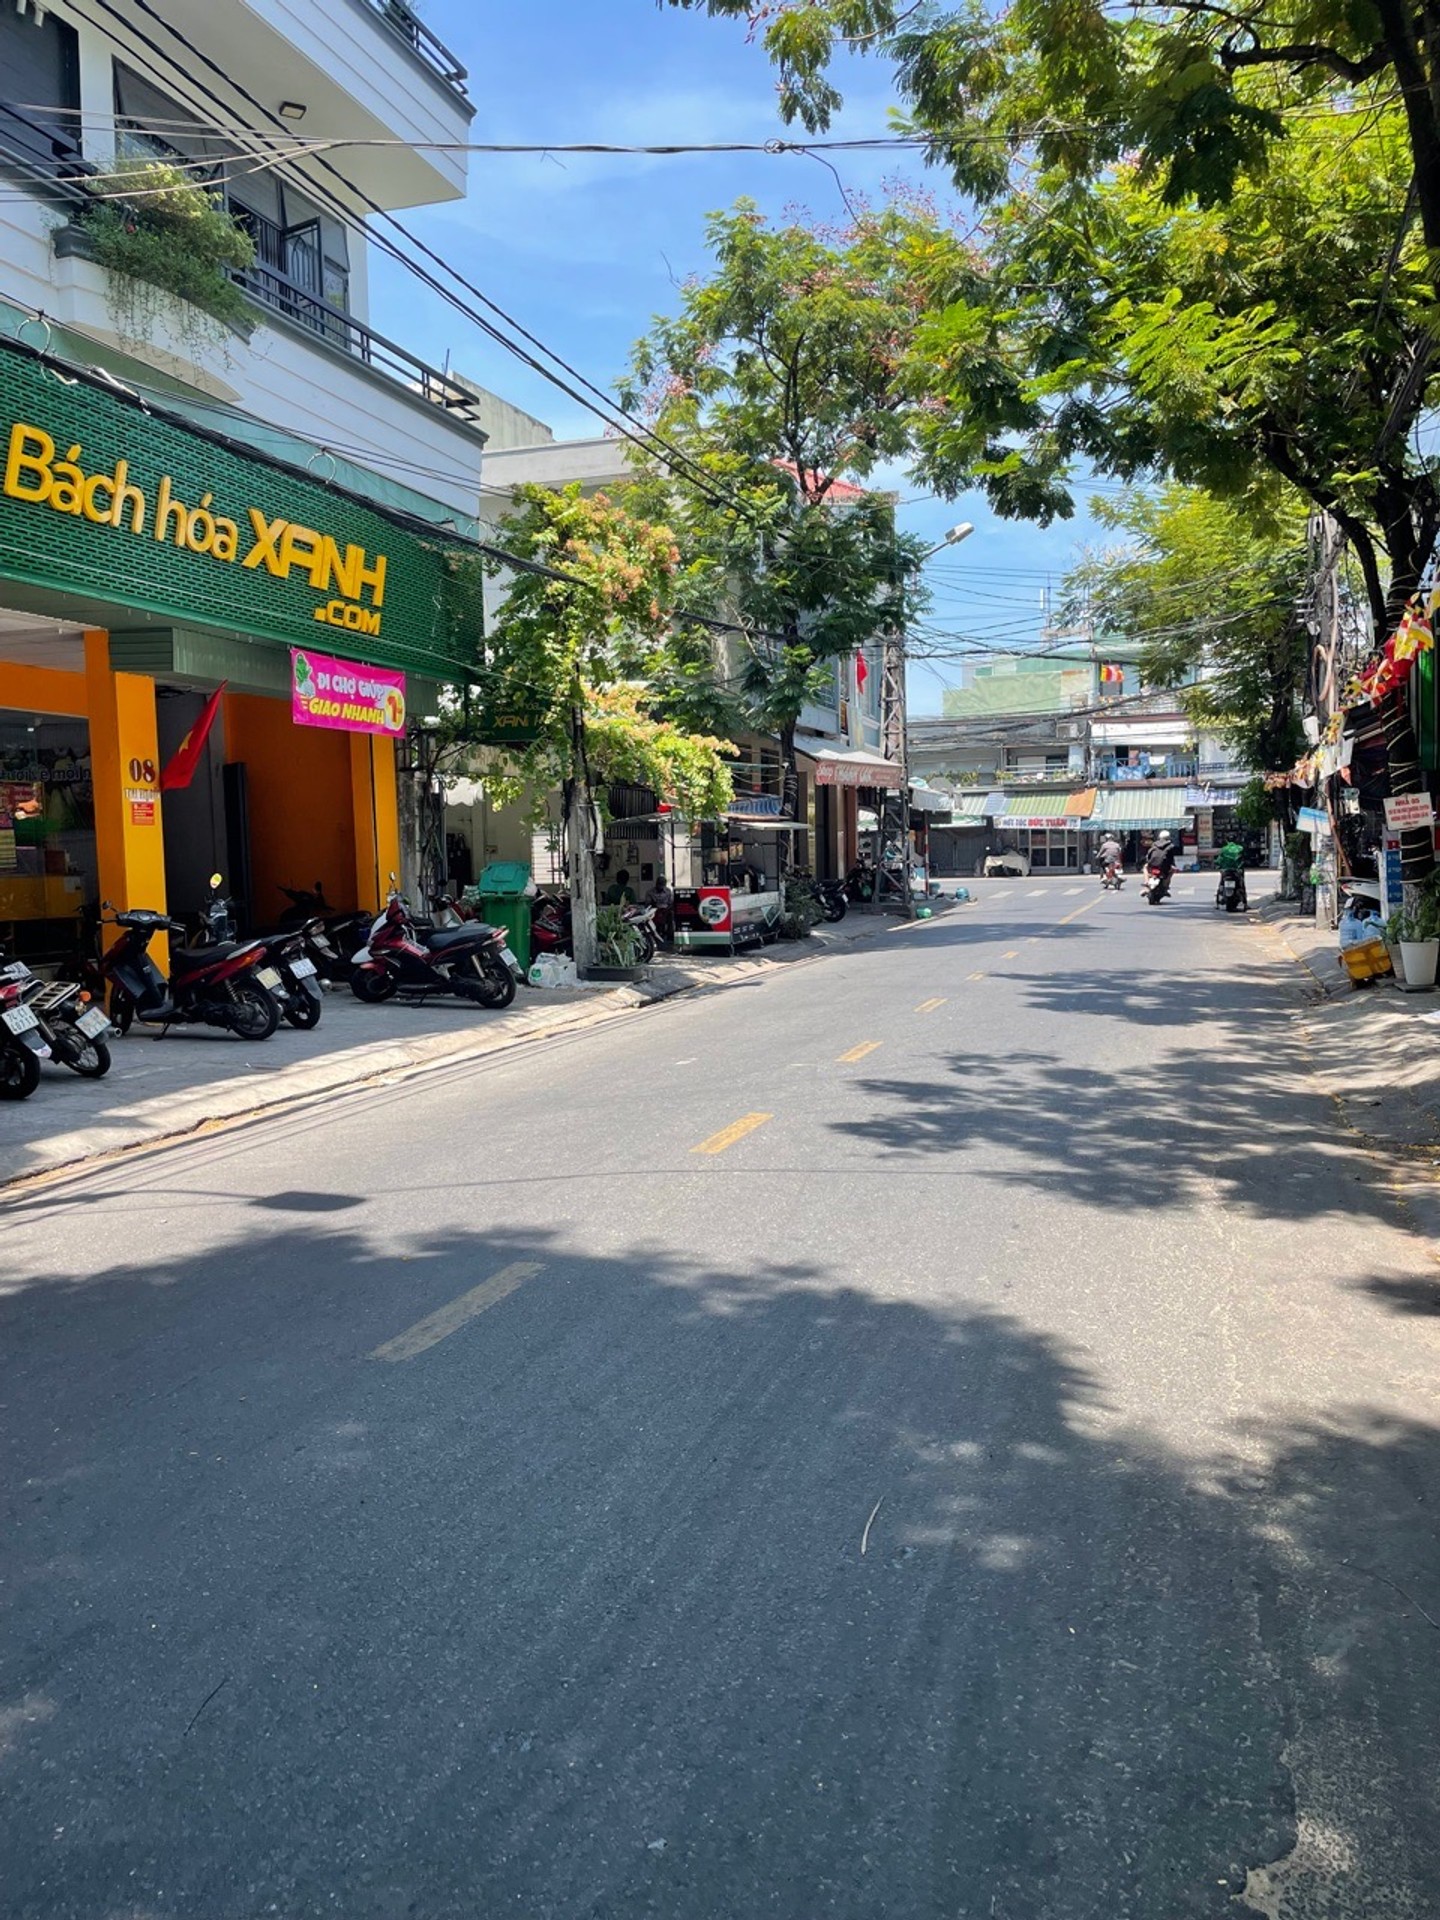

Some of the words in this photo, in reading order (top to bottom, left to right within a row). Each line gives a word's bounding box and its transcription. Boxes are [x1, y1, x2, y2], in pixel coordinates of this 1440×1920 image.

[4, 423, 145, 534] Bách
[155, 476, 239, 563] hóa
[241, 507, 387, 606] XANH
[314, 600, 381, 636] .COM
[332, 675, 356, 700] CHỢ
[309, 697, 340, 717] GIAO
[341, 703, 384, 724] NHANH
[129, 758, 156, 783] 08
